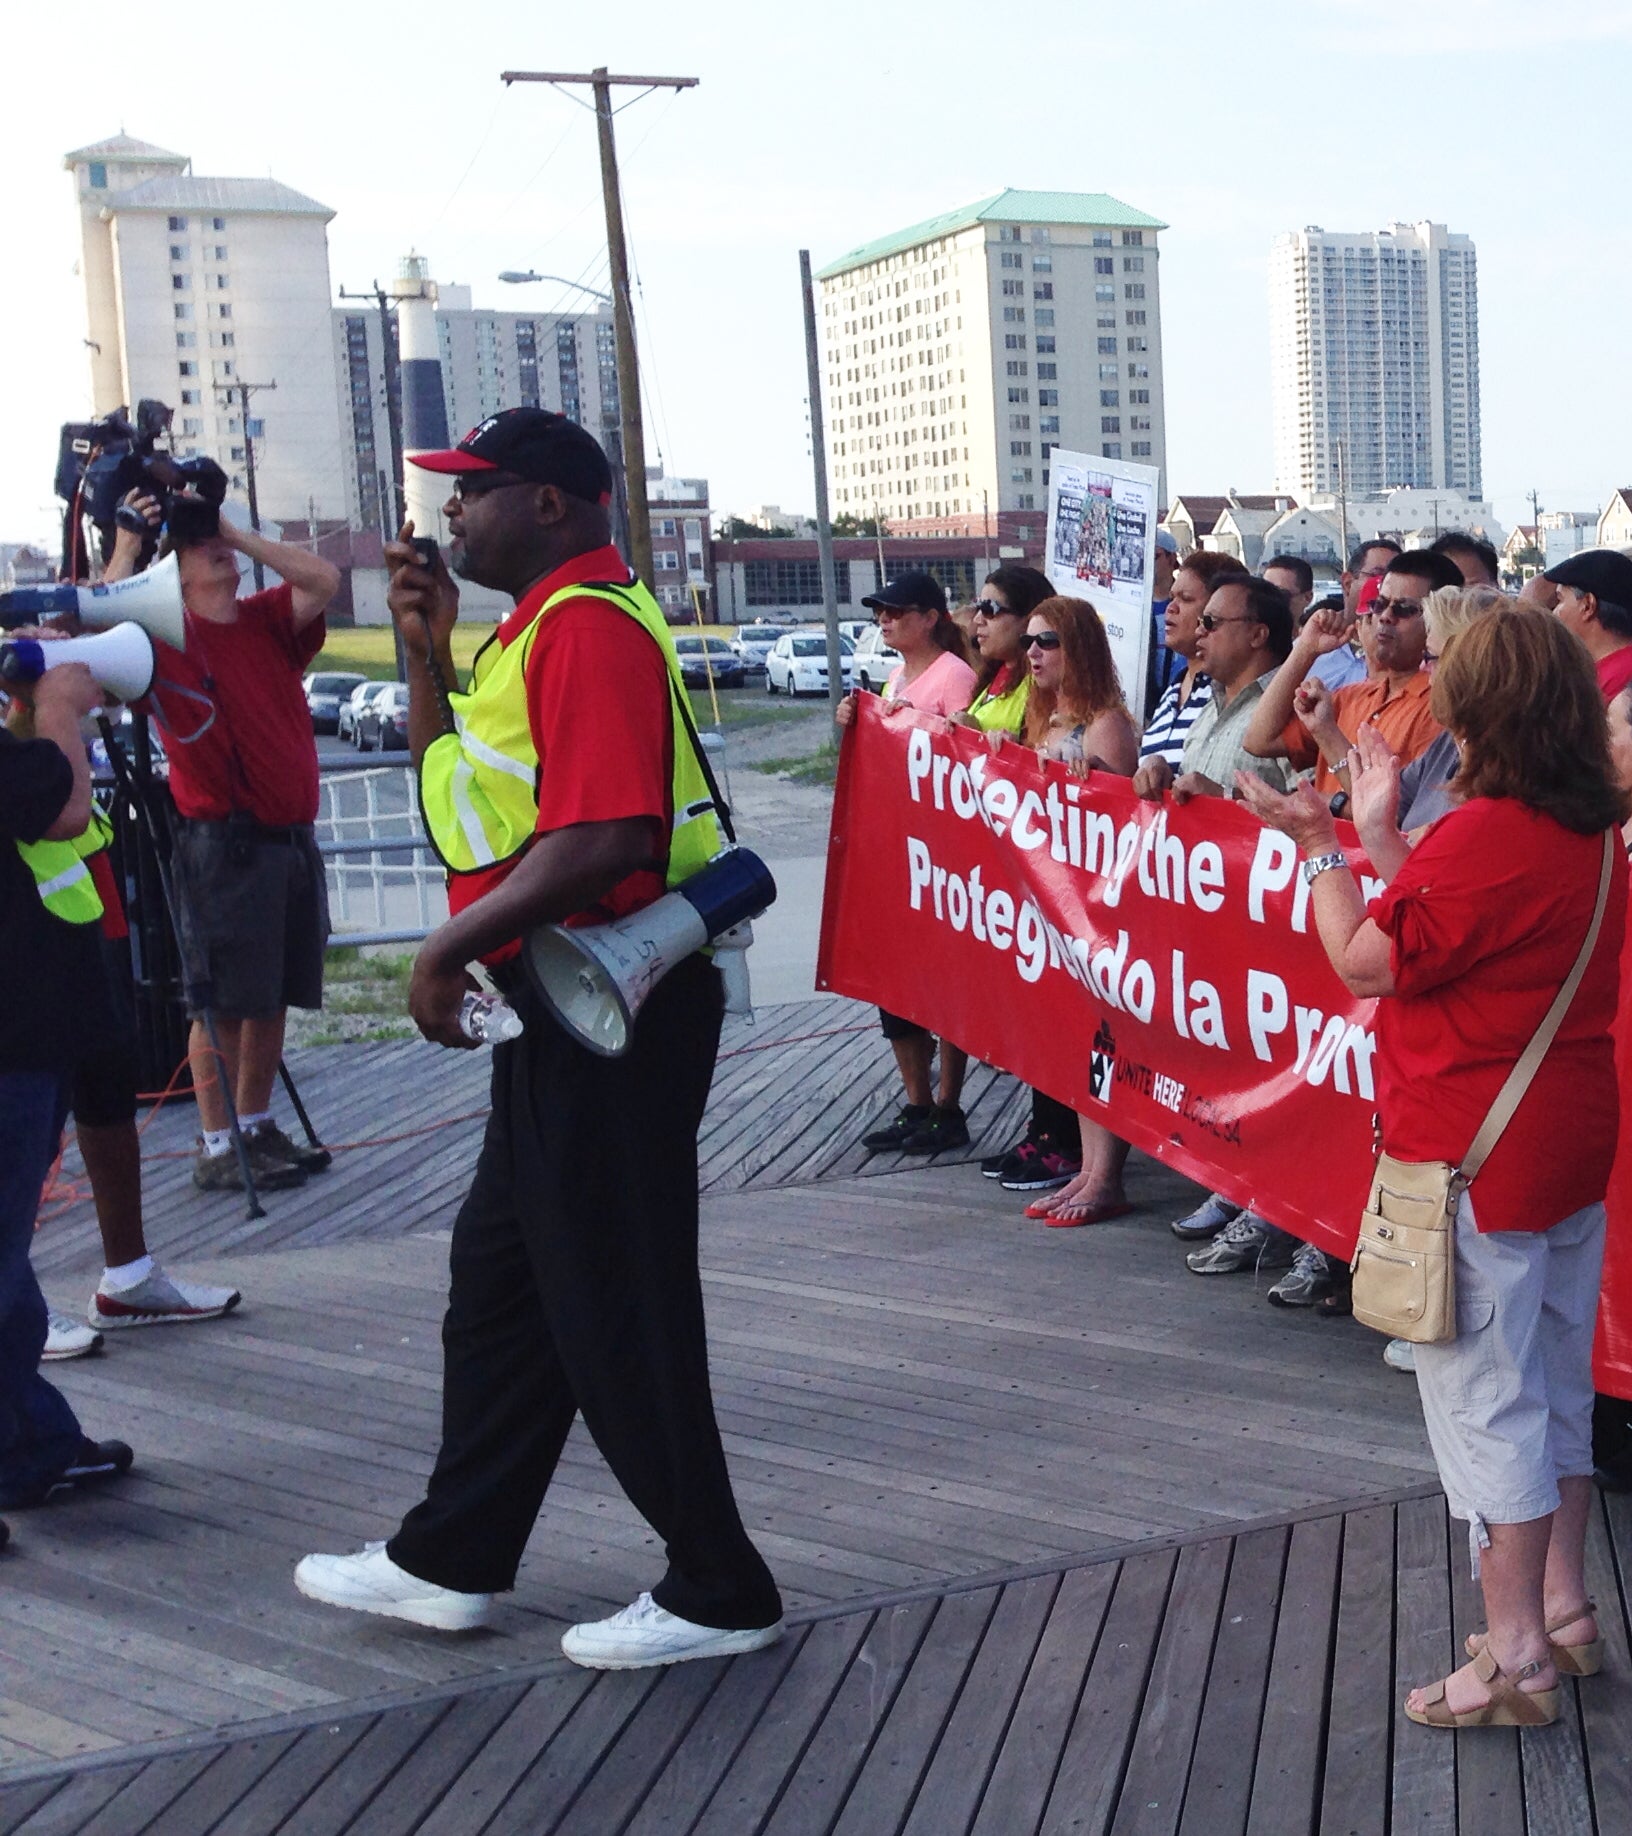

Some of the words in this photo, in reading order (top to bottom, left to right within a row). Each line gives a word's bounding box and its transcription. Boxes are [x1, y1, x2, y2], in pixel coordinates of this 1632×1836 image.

[1107, 622, 1124, 641] stop
[907, 728, 1142, 908] Protecting
[1137, 809, 1226, 913] the
[1171, 949, 1231, 1051] la
